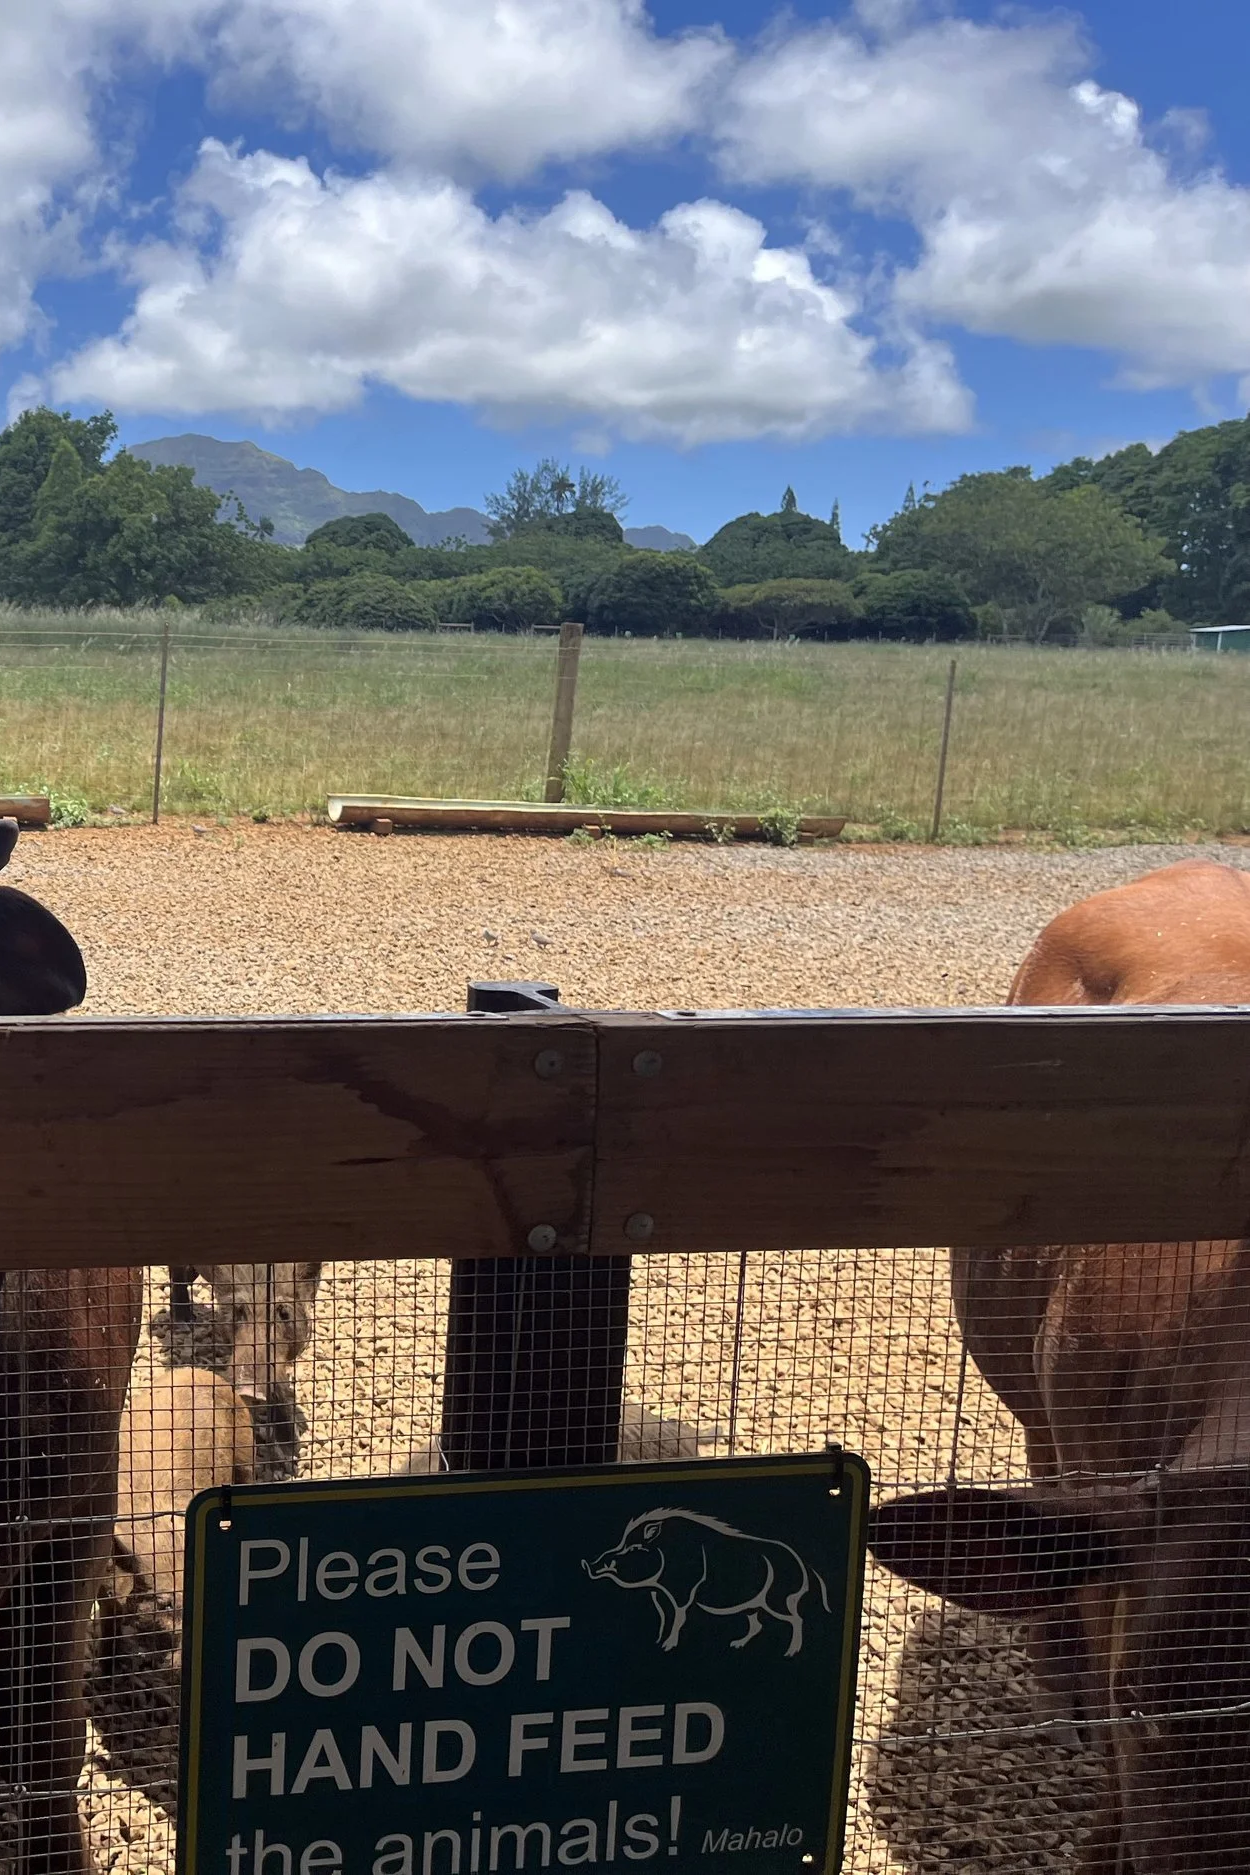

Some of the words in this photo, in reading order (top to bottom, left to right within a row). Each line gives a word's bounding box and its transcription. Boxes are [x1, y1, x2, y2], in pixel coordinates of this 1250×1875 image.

[239, 1538, 501, 1605] Please
[236, 1632, 361, 1703] DO
[393, 1617, 571, 1691] NOT
[232, 1720, 476, 1799] HAND
[509, 1702, 725, 1777] FEED
[225, 1829, 343, 1875] the
[372, 1796, 681, 1875] animals!
[701, 1823, 803, 1854] Mahalo
